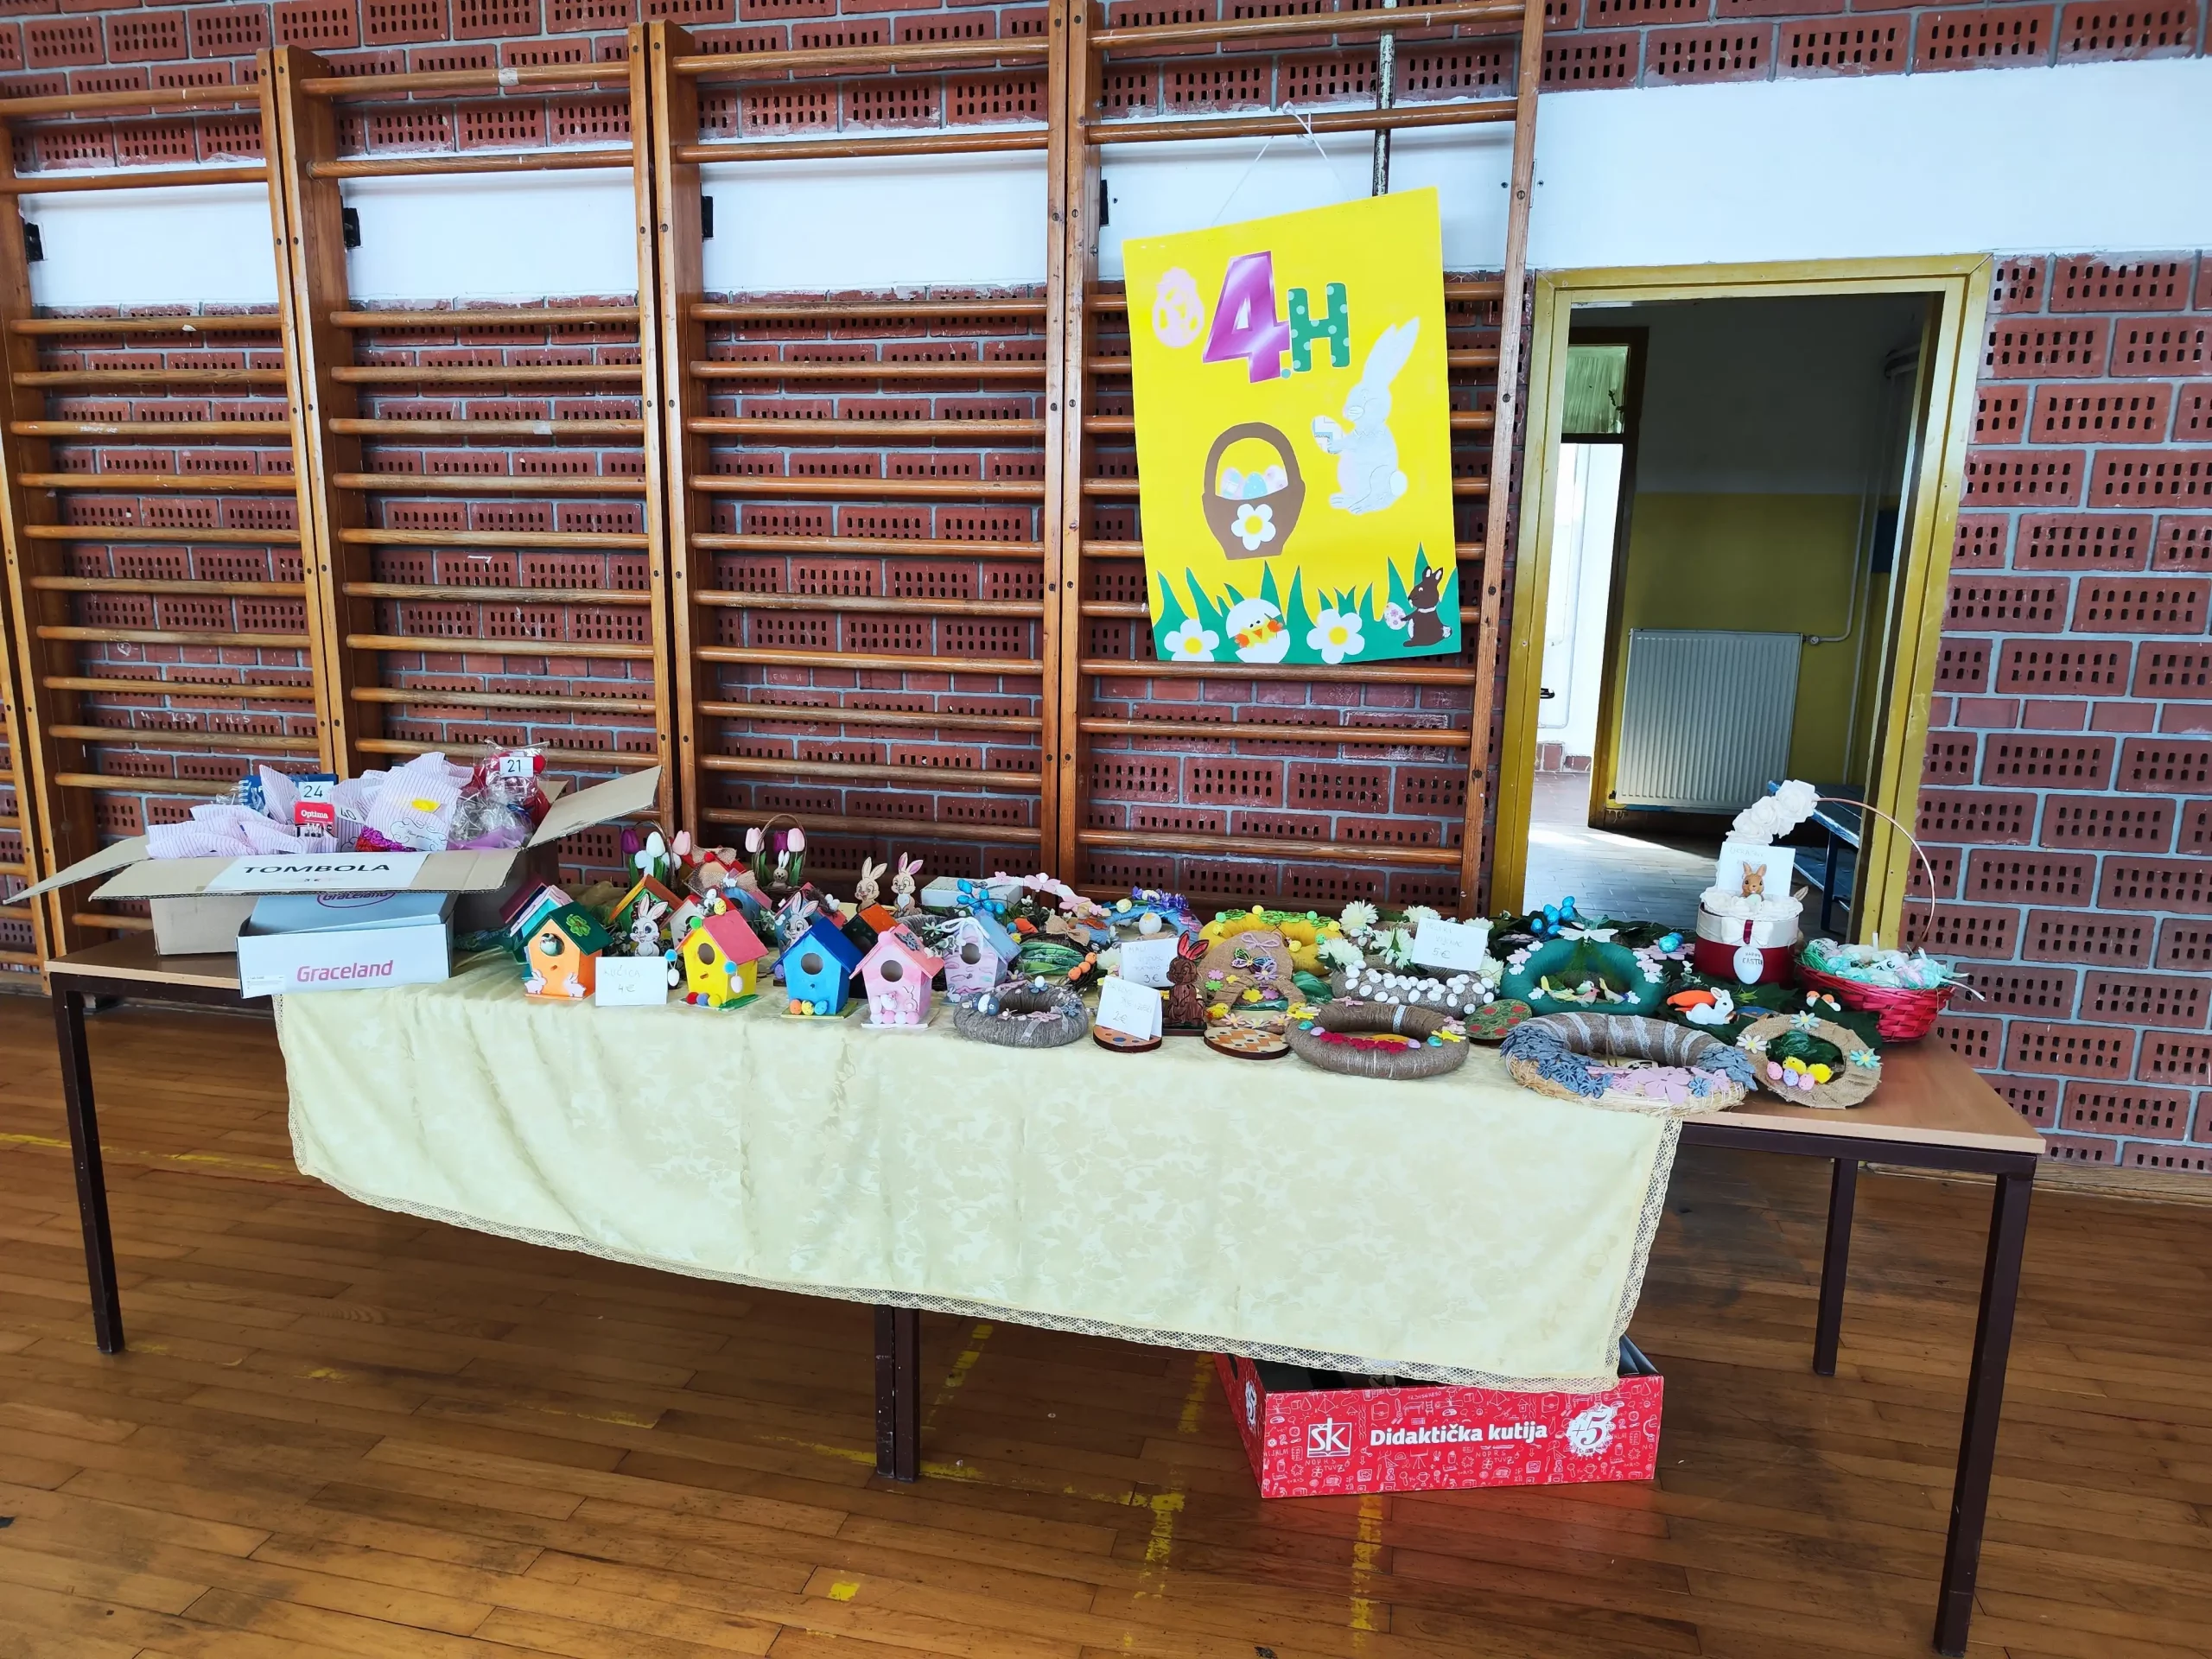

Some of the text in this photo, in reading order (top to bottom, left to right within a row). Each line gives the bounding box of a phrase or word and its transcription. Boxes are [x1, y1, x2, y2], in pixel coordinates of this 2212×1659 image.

[507, 760, 521, 772] 21
[303, 785, 323, 798] 24
[301, 809, 329, 819] Optima
[340, 807, 357, 820] 40
[244, 864, 391, 874] TOMBOLA
[297, 960, 393, 982] Graceland
[1370, 1421, 1548, 1446] Didaktička kutija
